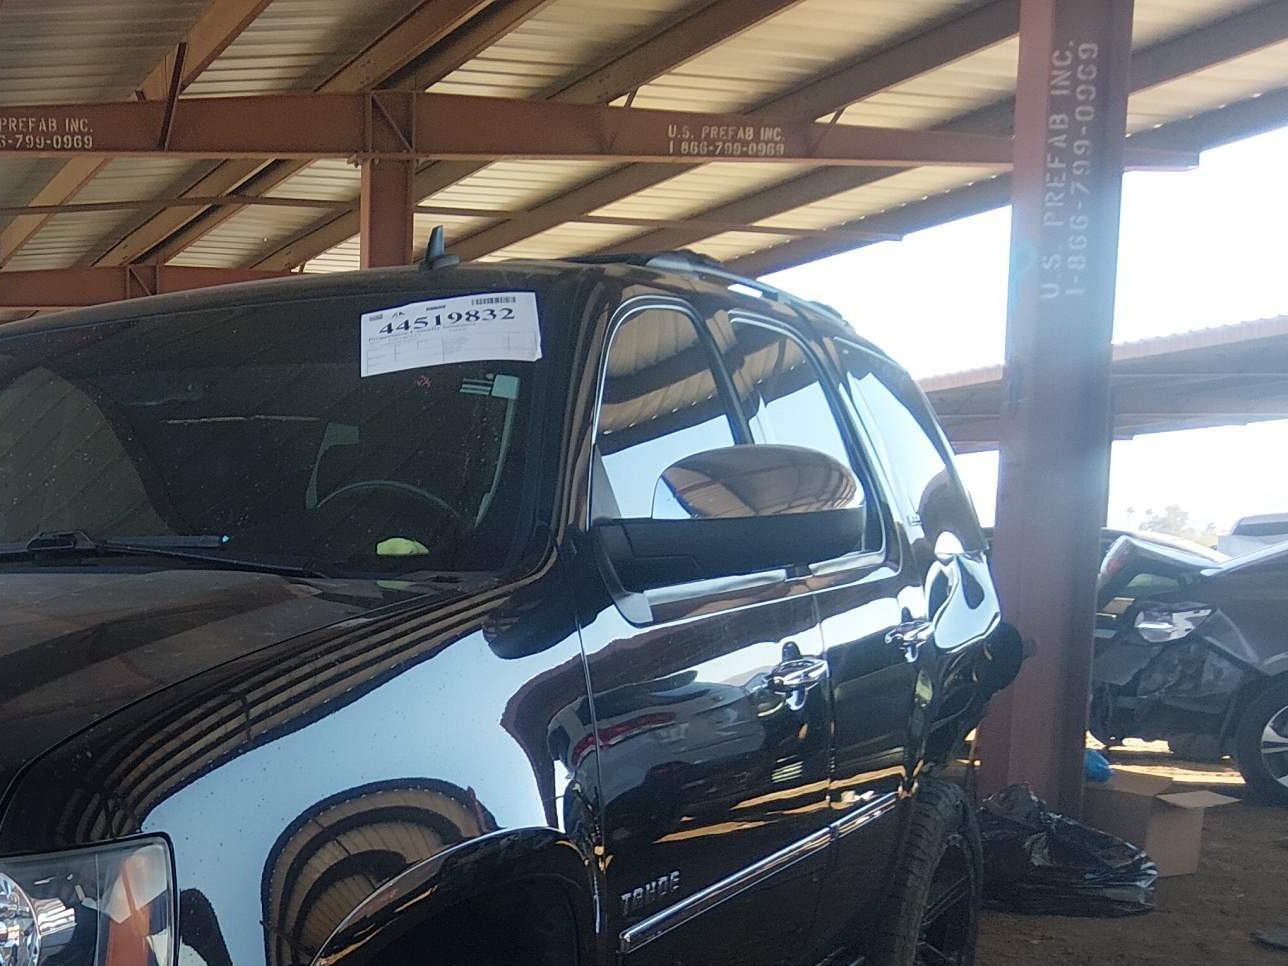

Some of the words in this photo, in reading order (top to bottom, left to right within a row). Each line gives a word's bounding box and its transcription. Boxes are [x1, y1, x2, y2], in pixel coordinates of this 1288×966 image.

[1050, 40, 1075, 95] INC.
[65, 118, 94, 133] INC.
[668, 124, 694, 138] U.S.
[701, 126, 754, 140] PREFAB
[760, 127, 785, 141] INC.
[1042, 113, 1070, 227] PREFAB
[1065, 43, 1099, 297] 1-866-799-0969
[379, 307, 515, 335] 44519832
[620, 870, 681, 916] TAHOE
